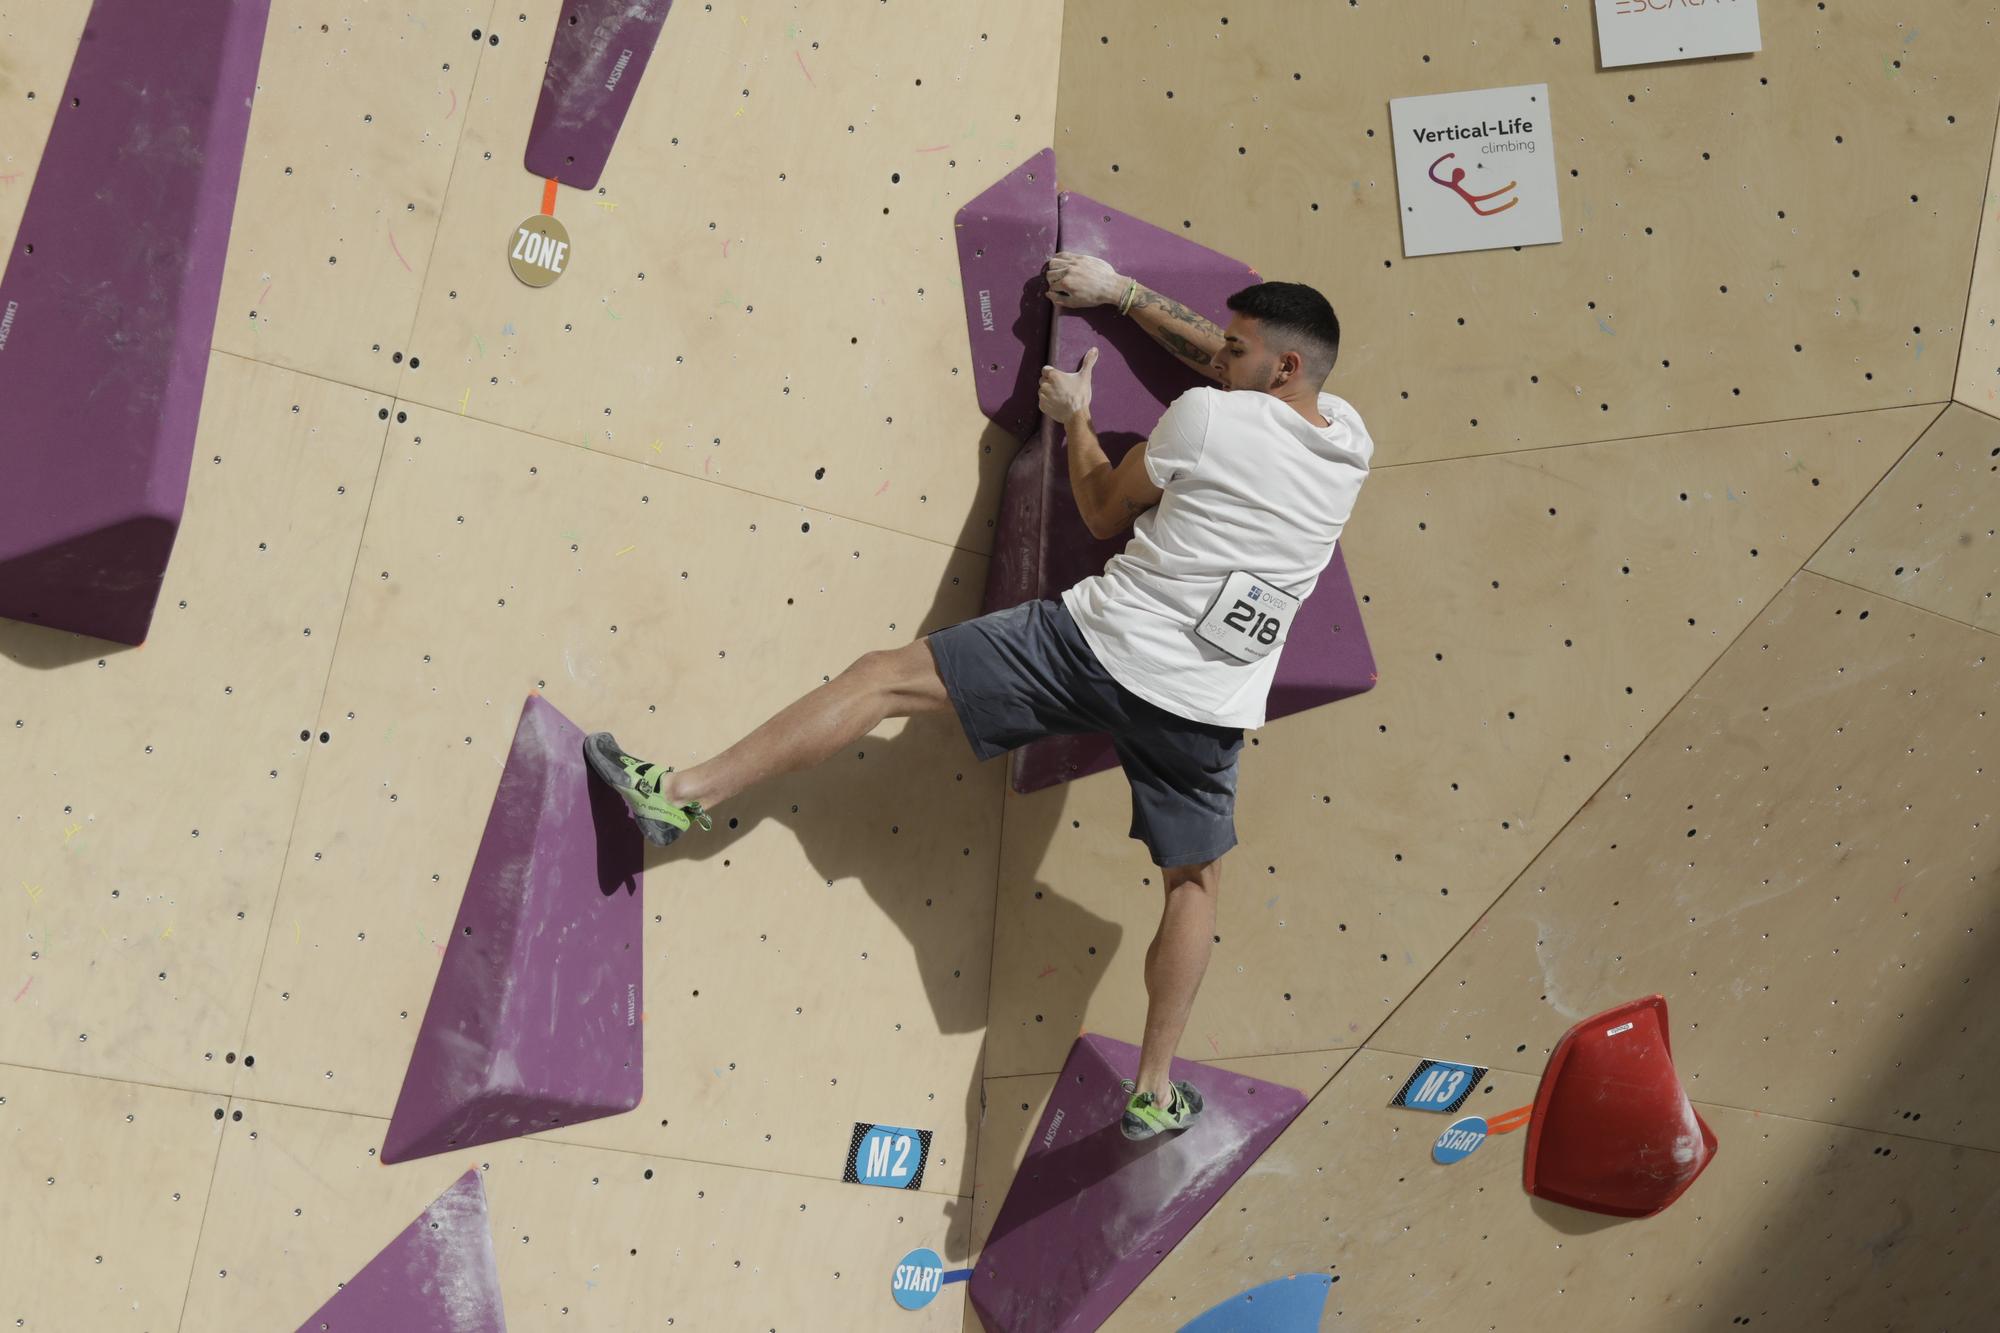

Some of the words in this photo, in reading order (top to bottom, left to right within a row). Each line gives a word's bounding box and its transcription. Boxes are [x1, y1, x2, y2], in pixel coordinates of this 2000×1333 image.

[1412, 117, 1533, 144] Vertical-Life
[1481, 140, 1536, 154] climbing
[511, 227, 569, 274] ZONE
[979, 289, 994, 332] CHIUSKY
[1223, 599, 1281, 645] 218
[1413, 1070, 1465, 1104] M3
[866, 1135, 912, 1178] M2
[1437, 1128, 1486, 1153] START
[893, 1264, 943, 1293] START
